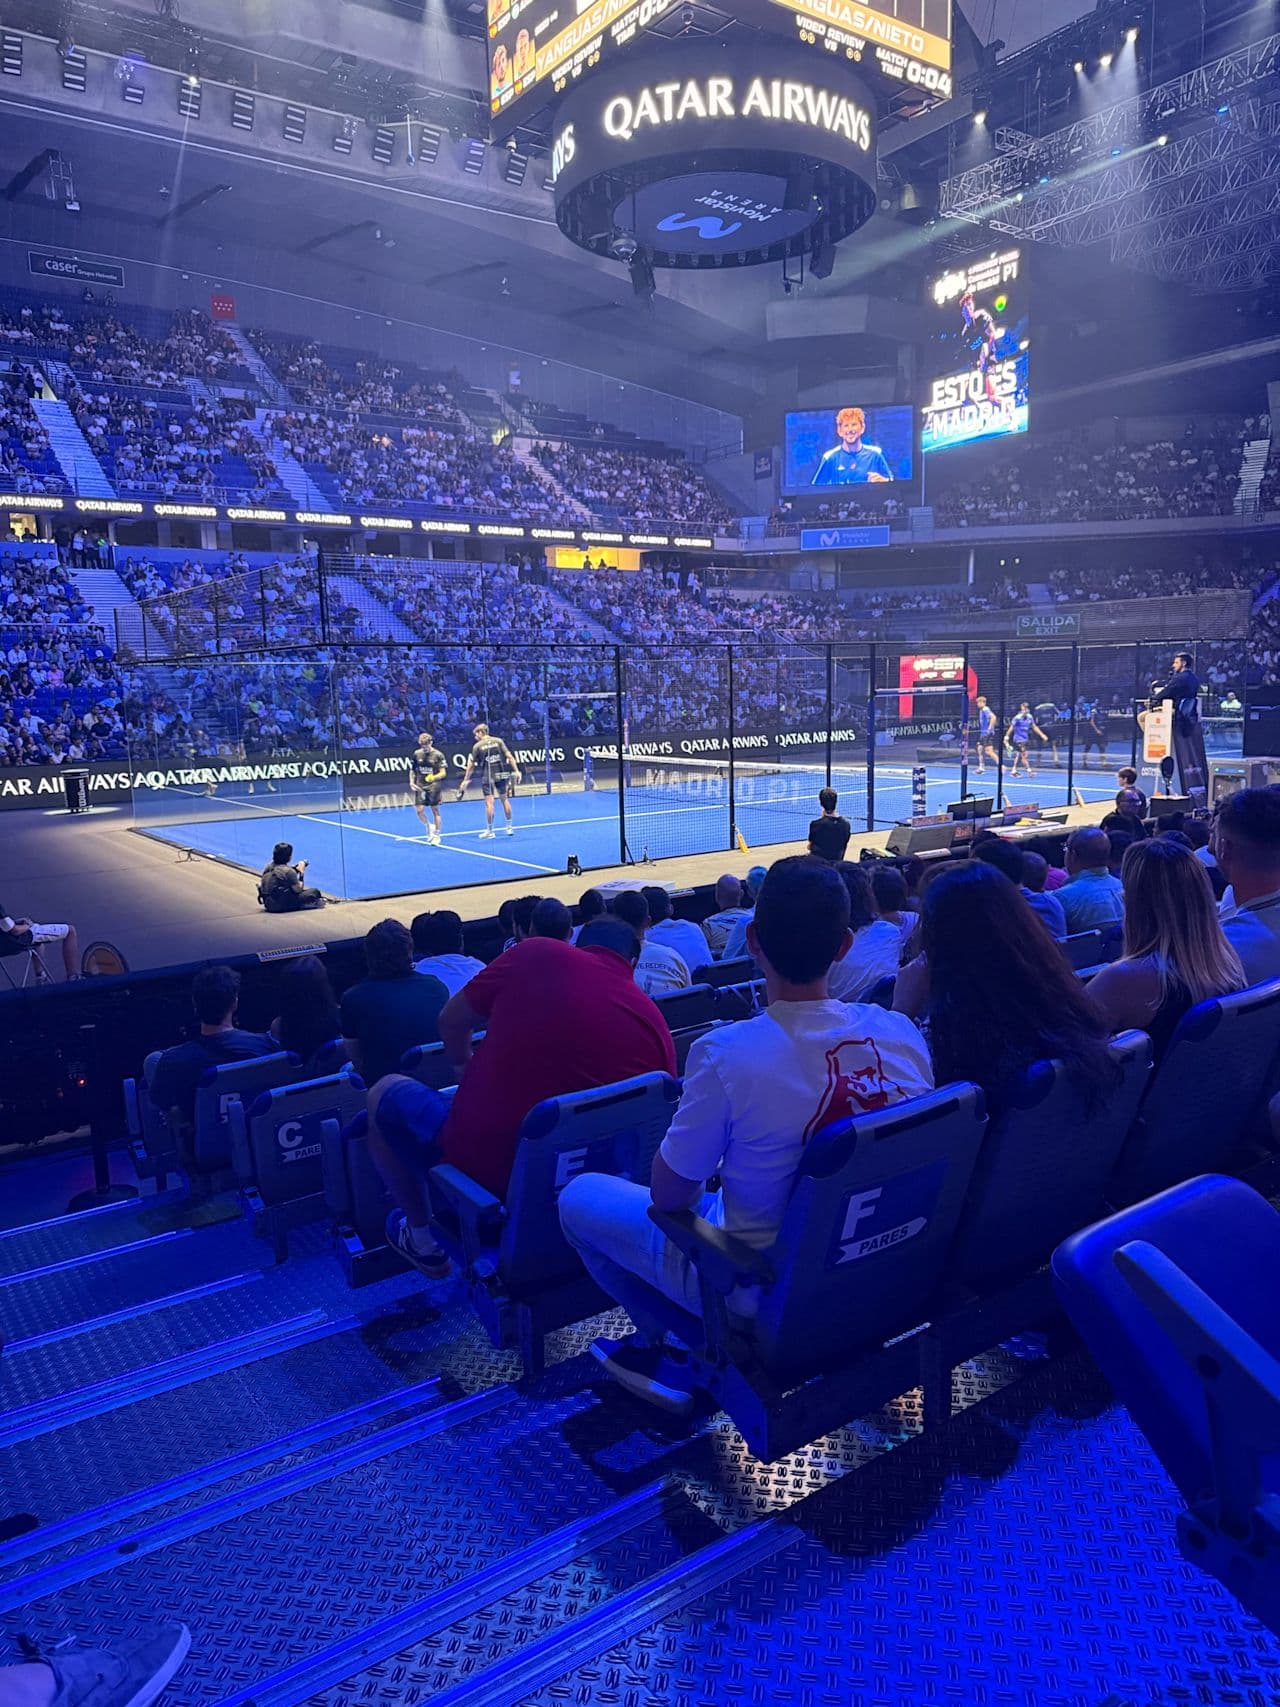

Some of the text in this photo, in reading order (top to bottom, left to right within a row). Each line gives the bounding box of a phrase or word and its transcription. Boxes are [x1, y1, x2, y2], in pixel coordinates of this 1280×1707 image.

[796, 14, 866, 50] VIDEO REVIEW
[876, 47, 908, 67] MATCH
[906, 60, 952, 95] 0:04
[604, 77, 871, 151] QATAR AIRWAYS
[694, 196, 771, 221] Movistar
[711, 190, 782, 213] ARENA
[45, 260, 78, 274] caser
[1003, 261, 1017, 281] P1
[932, 370, 984, 404] ESTO
[75, 500, 105, 511] QATAR
[1021, 616, 1075, 627] SALIDA
[1036, 626, 1059, 634] EXIT
[680, 739, 720, 754] QATAR
[775, 732, 811, 747] QATAR
[278, 1121, 303, 1148] C
[295, 1144, 321, 1158] PARE
[841, 1187, 882, 1240] F
[860, 1225, 909, 1256] PARES
